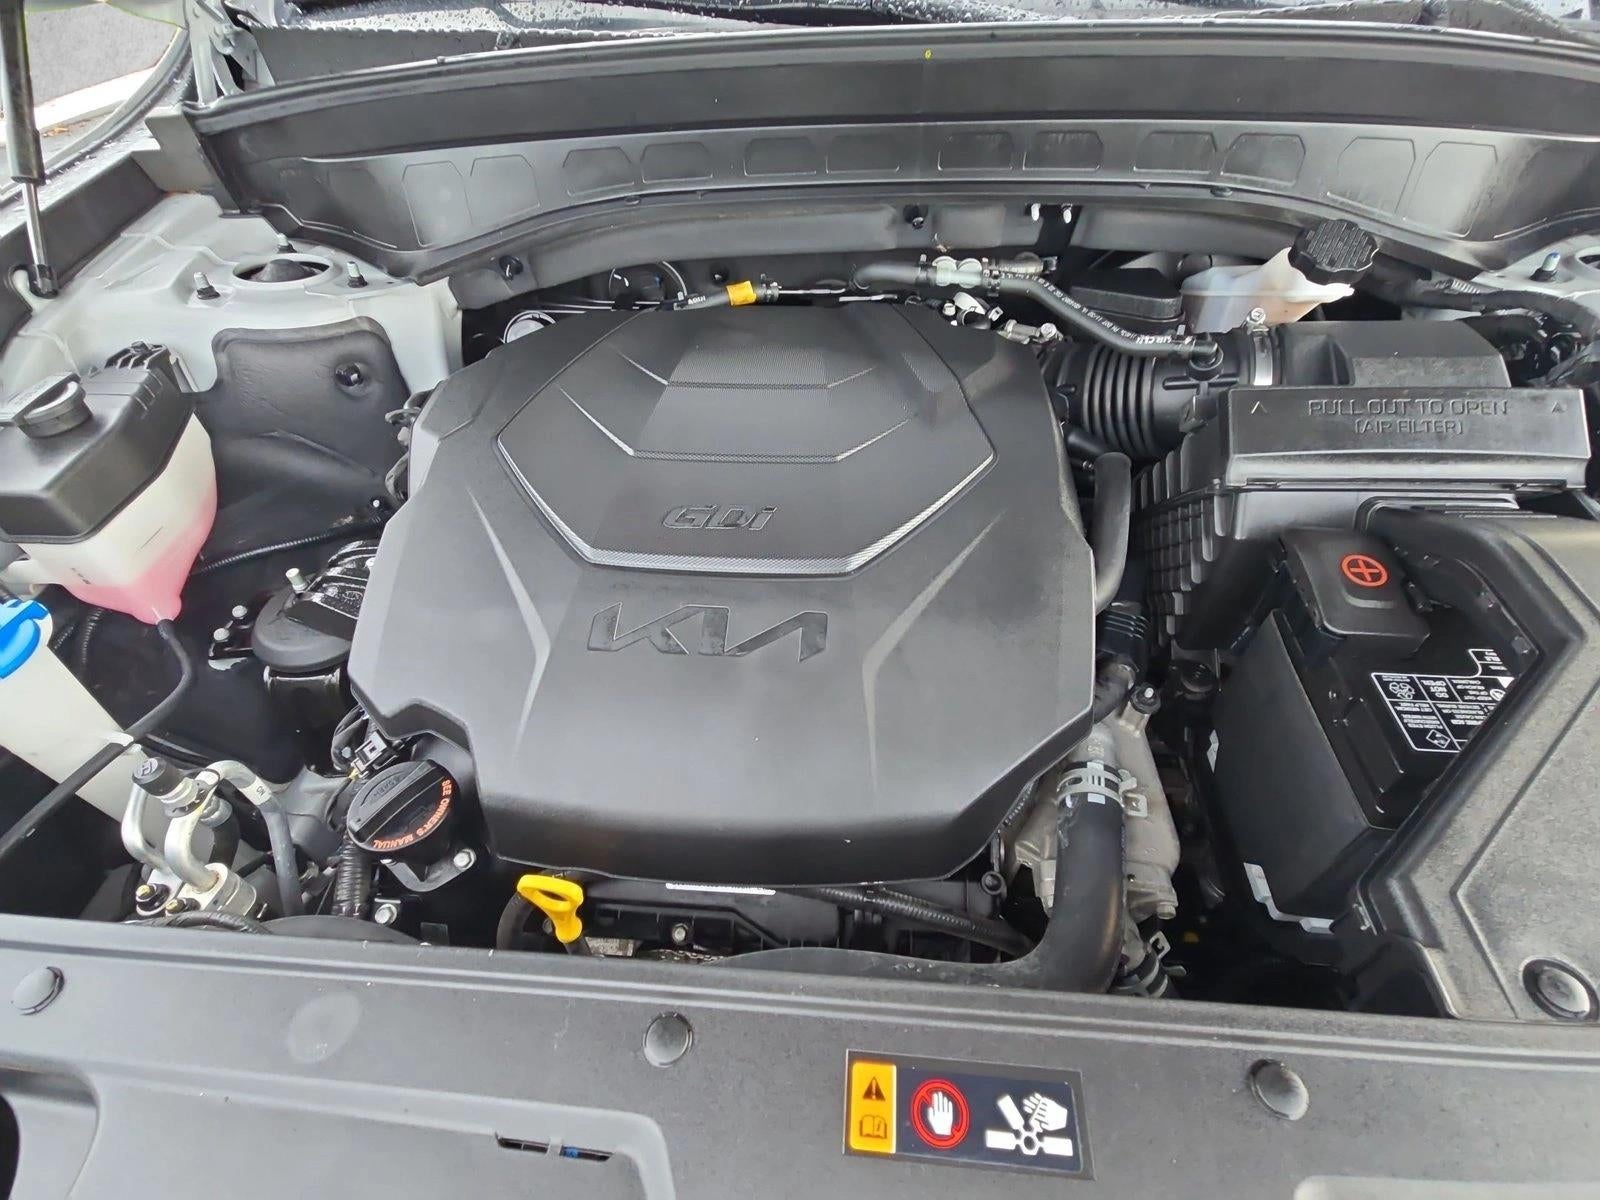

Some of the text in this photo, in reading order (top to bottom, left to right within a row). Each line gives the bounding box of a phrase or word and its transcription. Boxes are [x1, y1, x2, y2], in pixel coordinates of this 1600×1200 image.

[1308, 399, 1510, 415] PULL OUT TO OPEN
[661, 505, 778, 531] GDi
[373, 779, 453, 849] SEE OWNER'S MANUAL
